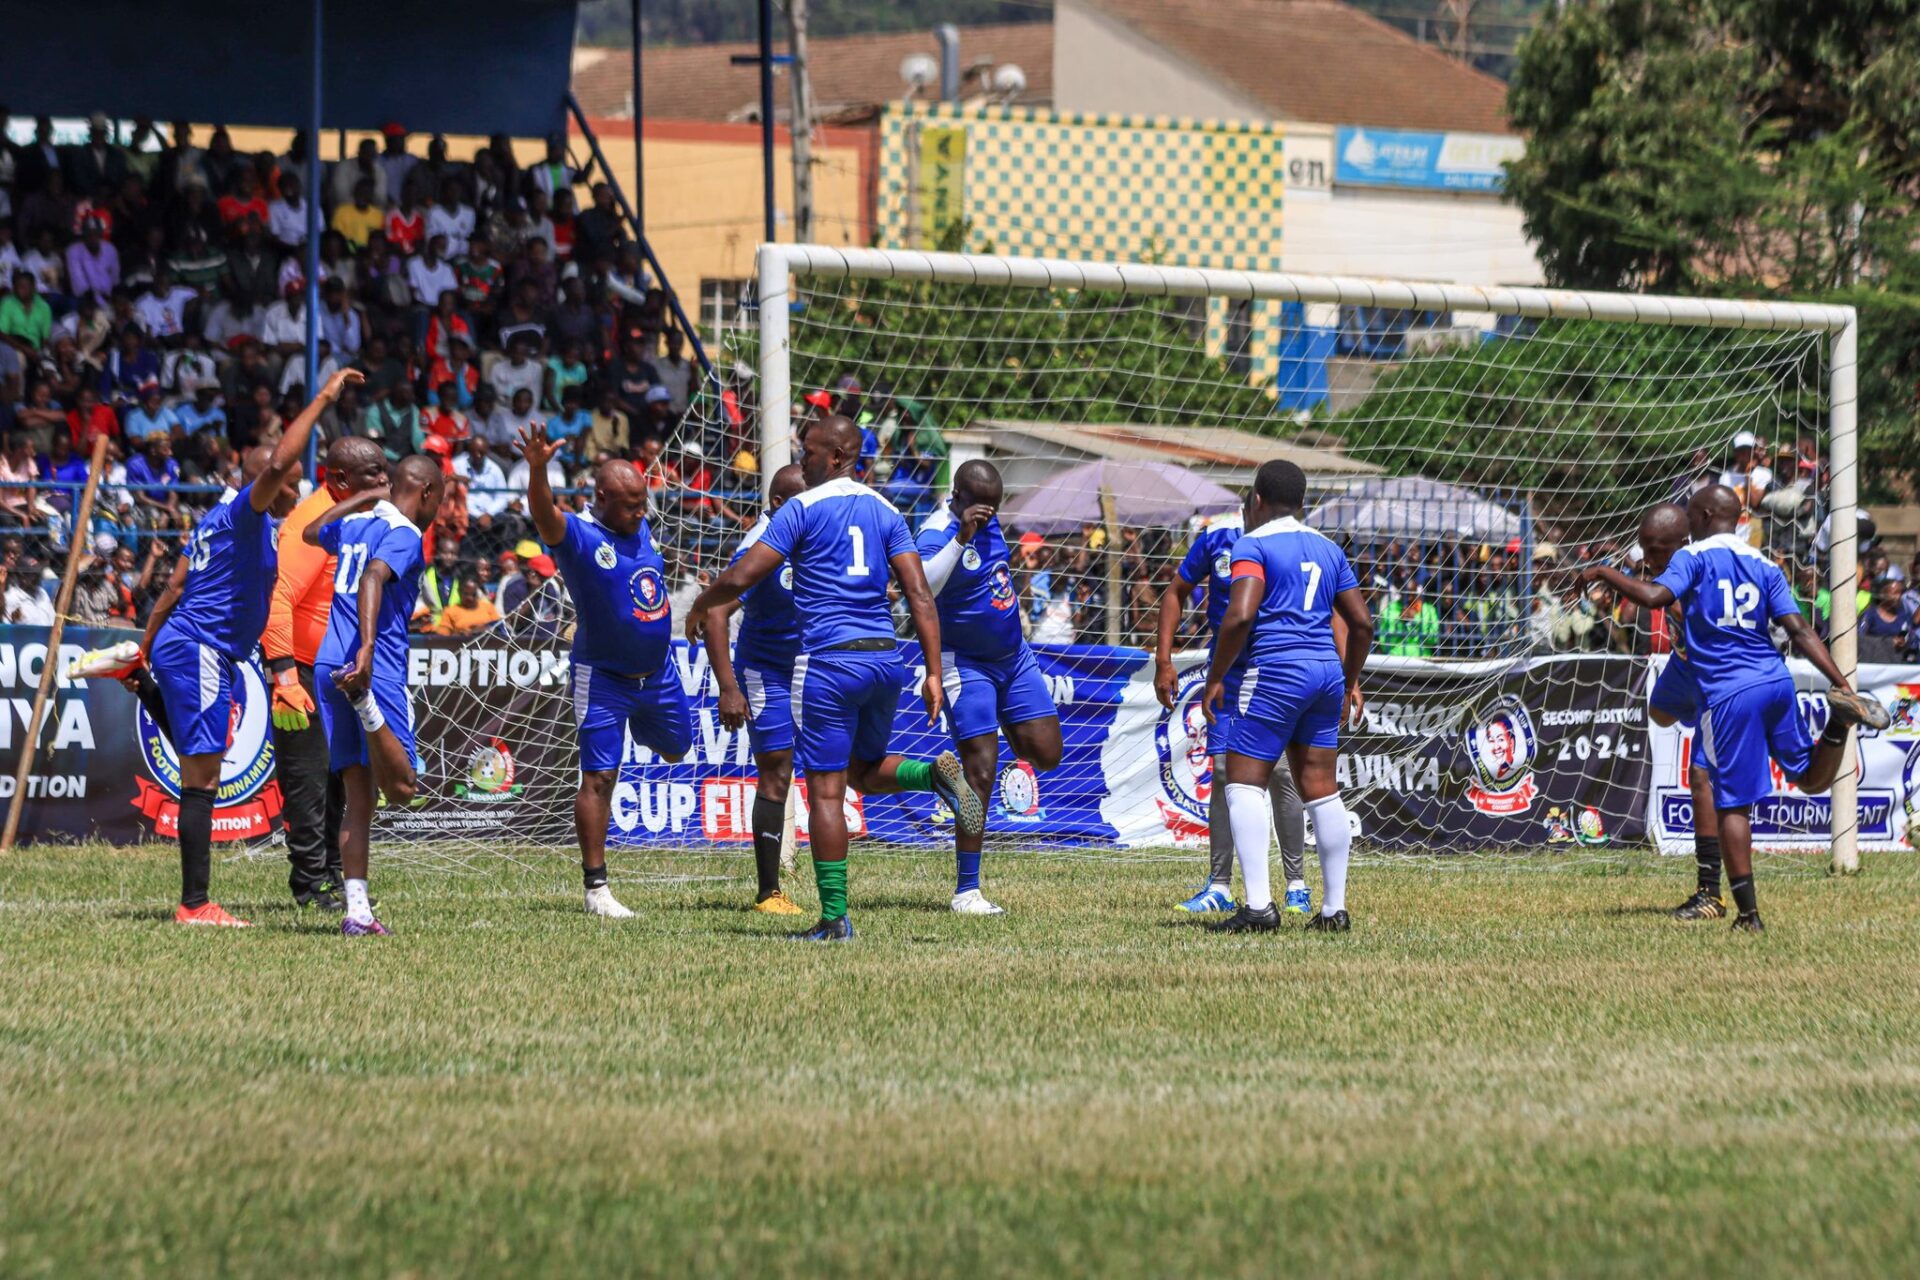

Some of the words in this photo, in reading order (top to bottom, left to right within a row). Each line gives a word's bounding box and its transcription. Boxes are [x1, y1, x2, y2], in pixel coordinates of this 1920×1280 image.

[335, 543, 368, 594] 17
[847, 526, 869, 576] 1
[1301, 562, 1322, 611] 7
[1717, 579, 1760, 629] 12
[407, 649, 570, 686] EDITION
[1542, 711, 1593, 726] SECOND
[1594, 707, 1643, 724] EDITION
[1335, 753, 1440, 791] AVINYA
[611, 782, 696, 833] CUP
